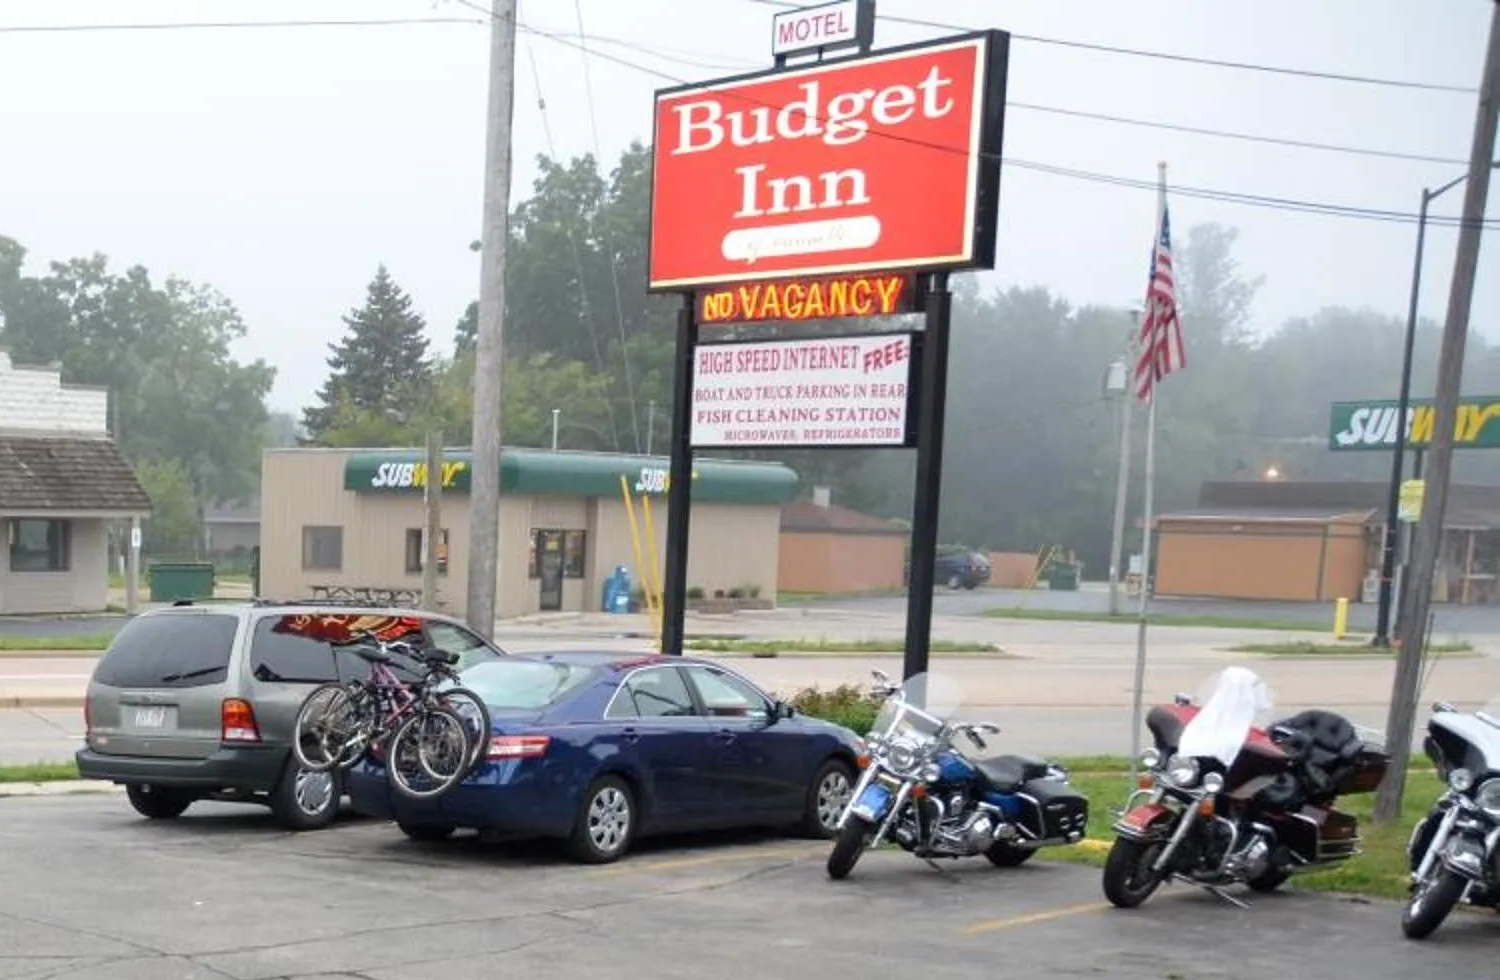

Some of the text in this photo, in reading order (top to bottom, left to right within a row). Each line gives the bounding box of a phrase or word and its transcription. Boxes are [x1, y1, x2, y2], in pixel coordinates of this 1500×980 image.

[778, 12, 850, 44] MOTEL
[670, 65, 954, 155] Budget
[733, 162, 871, 219] Inn
[703, 276, 901, 321] NO VACANCY
[699, 350, 733, 374] HIGH
[736, 348, 781, 373] SPEED
[783, 345, 861, 371] INTERNET
[694, 383, 907, 402] BOAT AND TRUCK PARKING IN REAR
[697, 406, 901, 424] FISH CLEANING STATION
